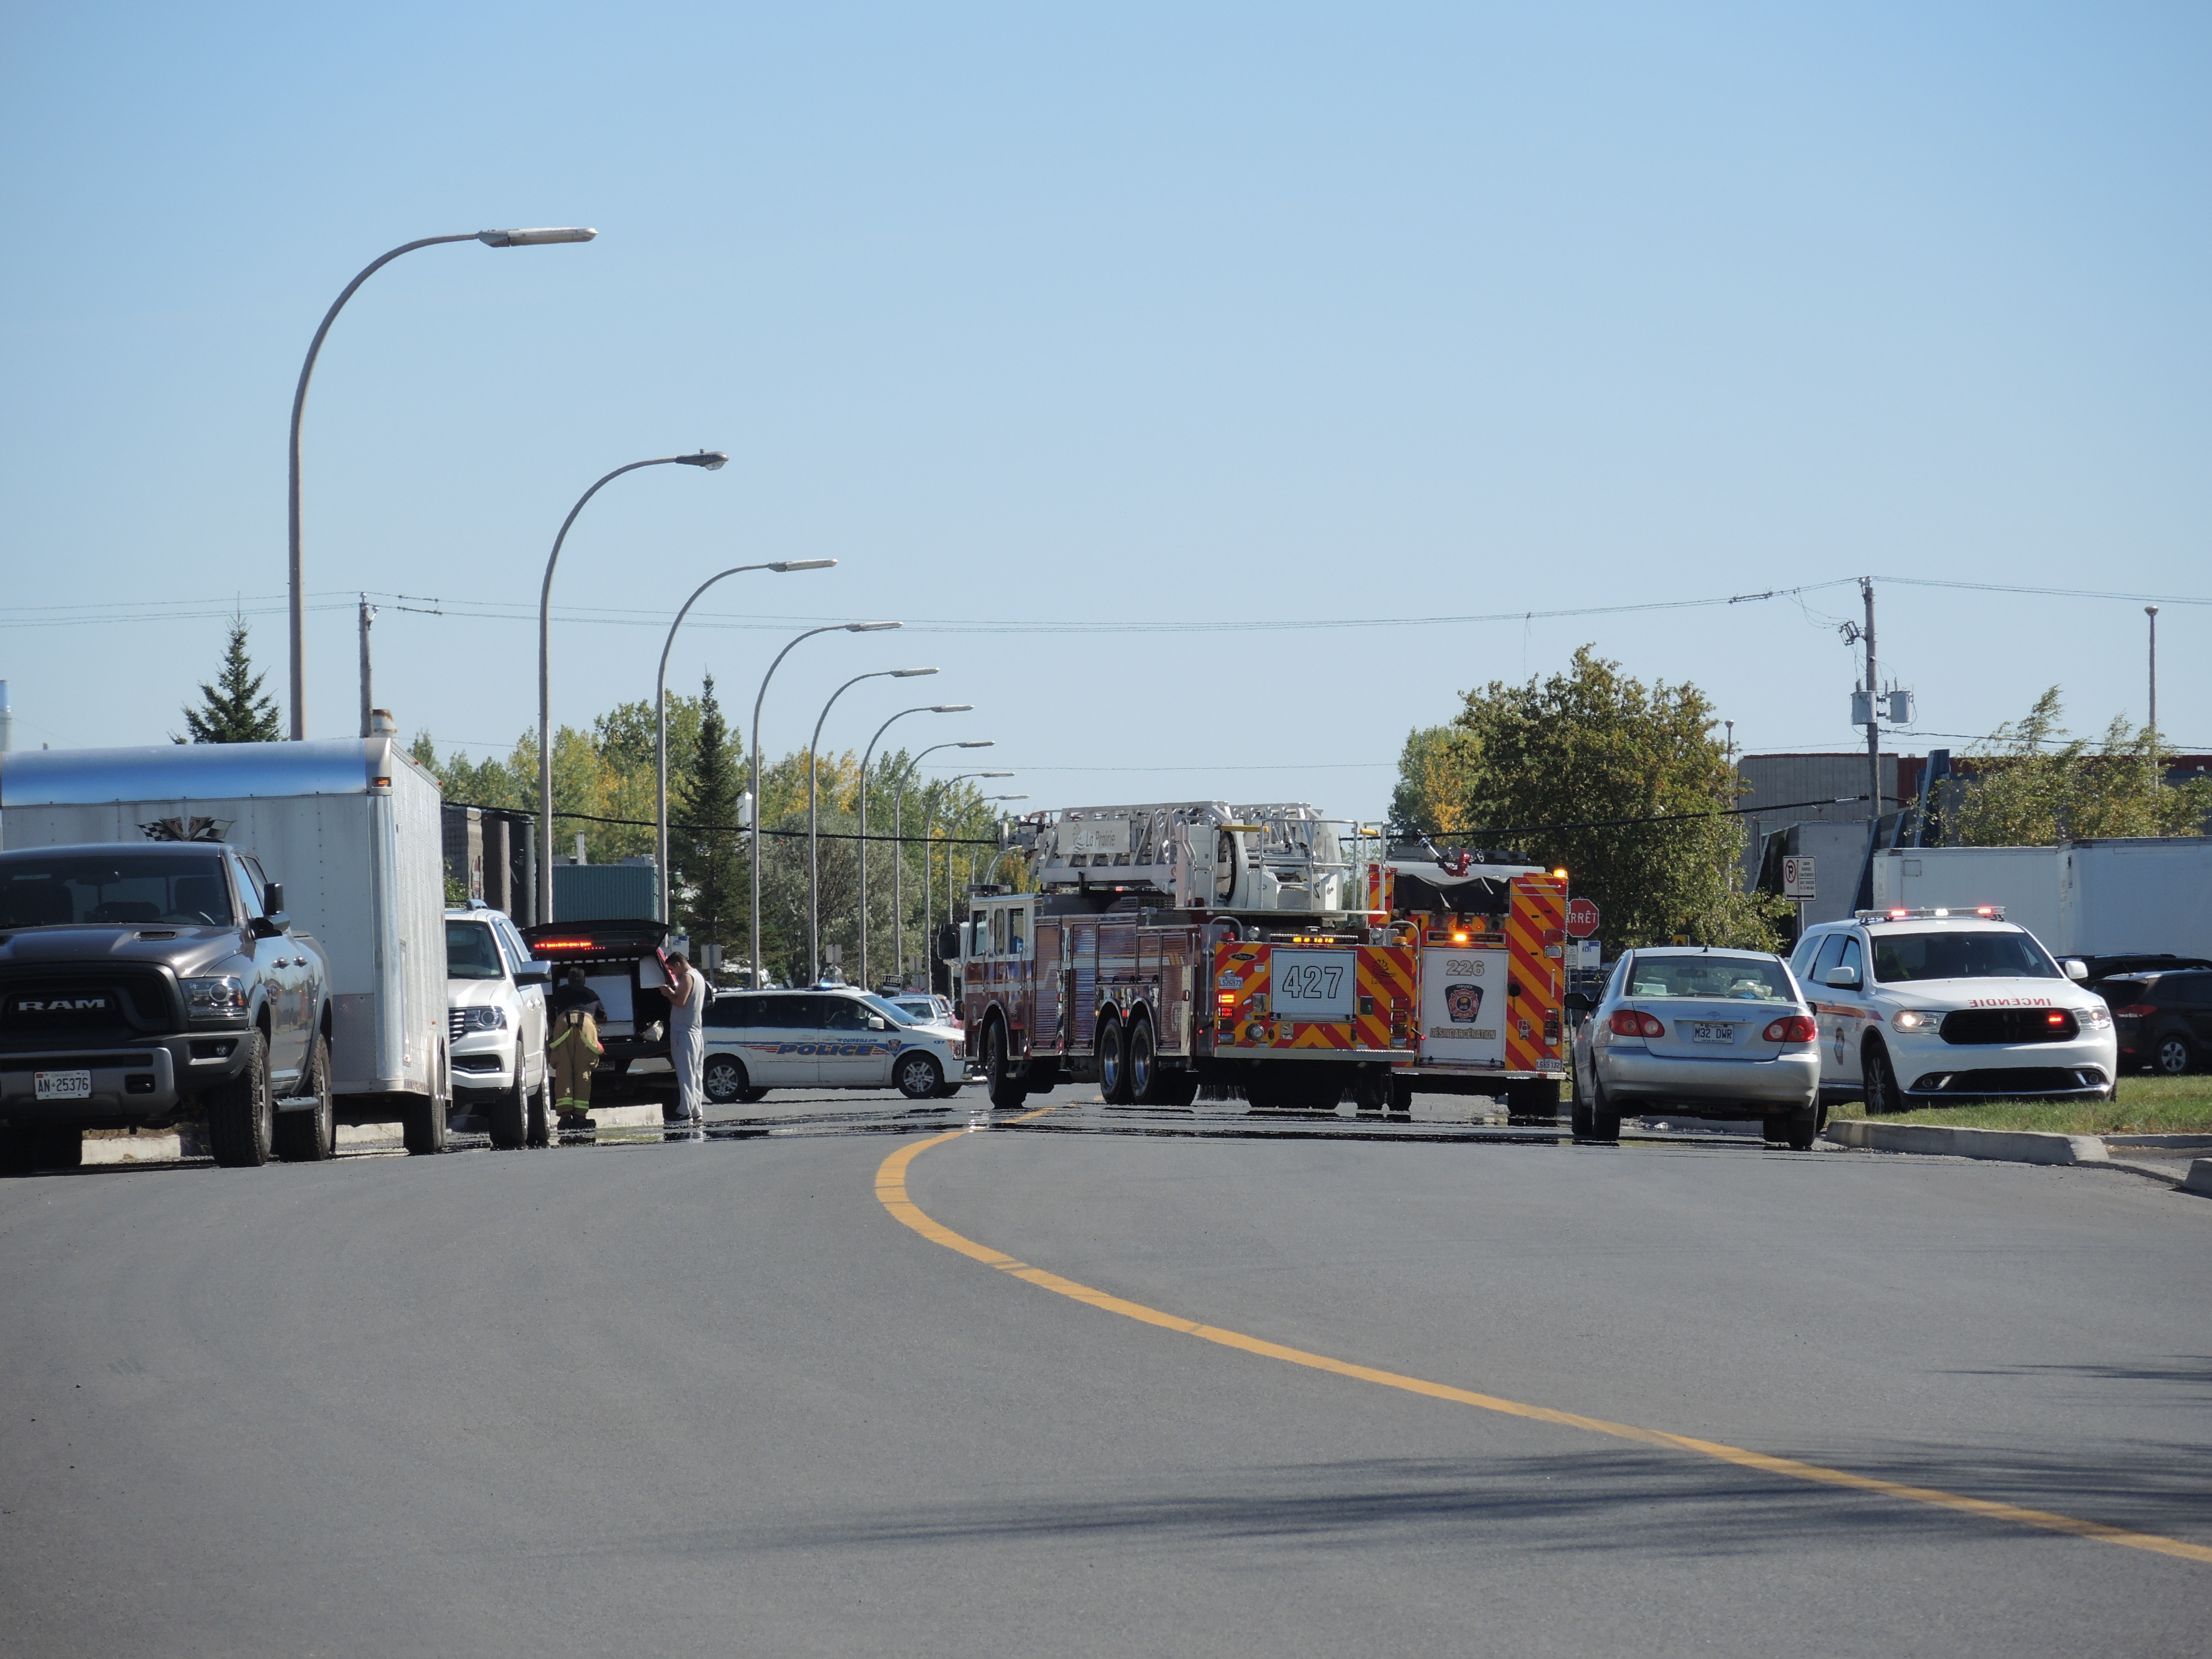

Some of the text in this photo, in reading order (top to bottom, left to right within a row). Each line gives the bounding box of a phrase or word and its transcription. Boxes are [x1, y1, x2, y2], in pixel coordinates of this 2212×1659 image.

[1086, 831, 1115, 847] La Prairie
[1446, 959, 1485, 977] 226
[1282, 966, 1344, 999] 427
[18, 999, 106, 1011] RAM
[1430, 1026, 1496, 1040] DÉSINCARCÉRATION
[1694, 1027, 1732, 1039] M32 DWR
[776, 1043, 876, 1057] POLICE
[56, 1077, 89, 1092] 25376
